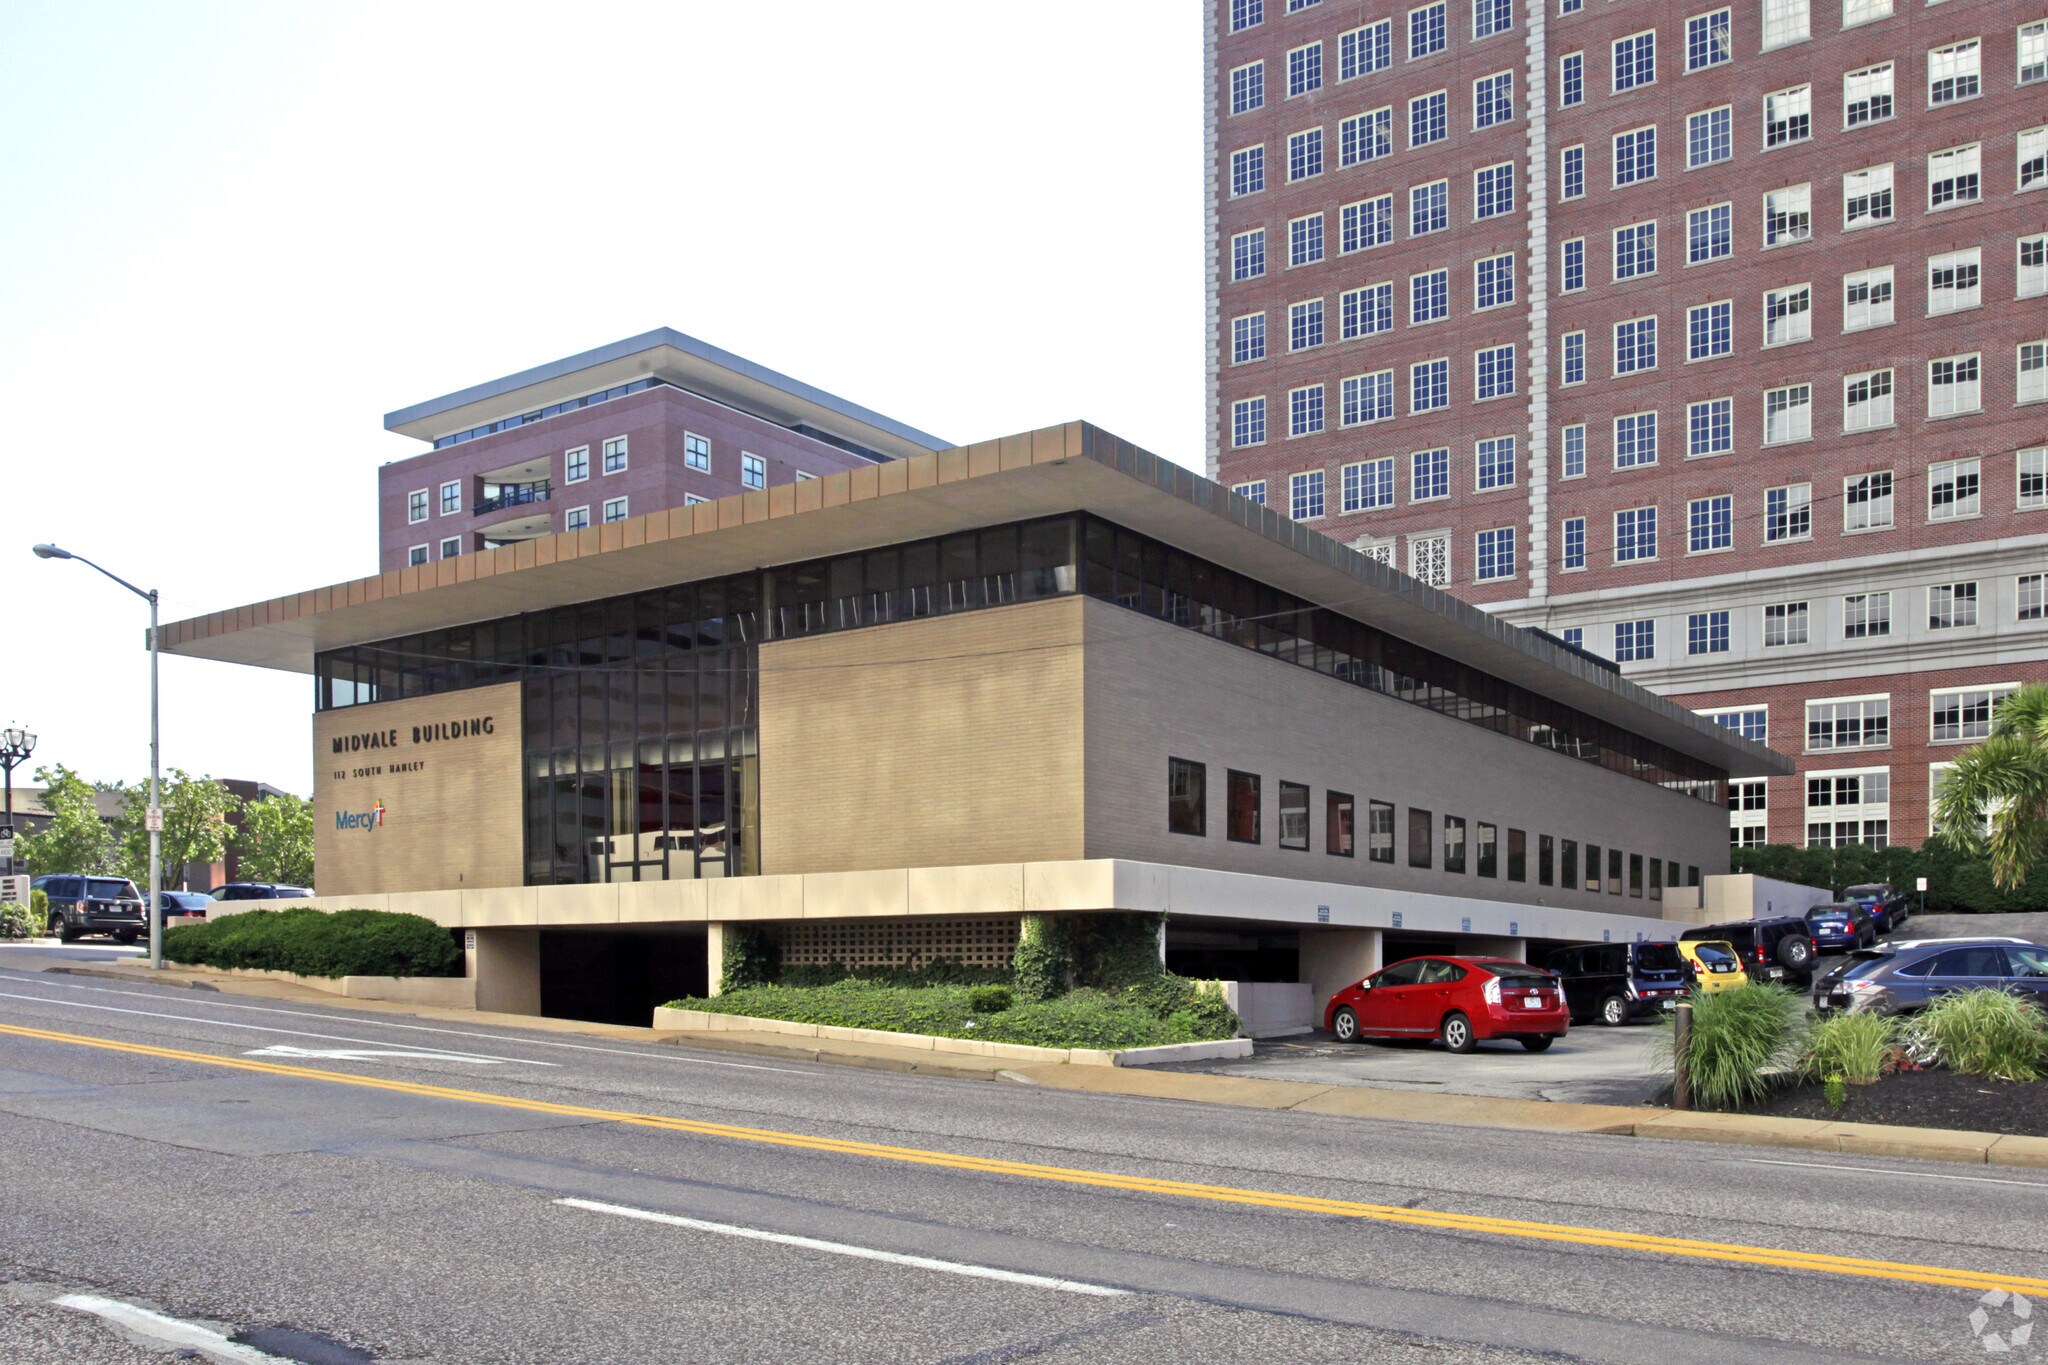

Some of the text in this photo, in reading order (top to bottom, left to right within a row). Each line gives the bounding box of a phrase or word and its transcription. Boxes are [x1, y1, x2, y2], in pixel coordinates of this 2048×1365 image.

[332, 716, 494, 753] MIDVALE BUILDING
[333, 761, 425, 780] 112 SOUTH HANLEY
[336, 810, 375, 832] Mercy
